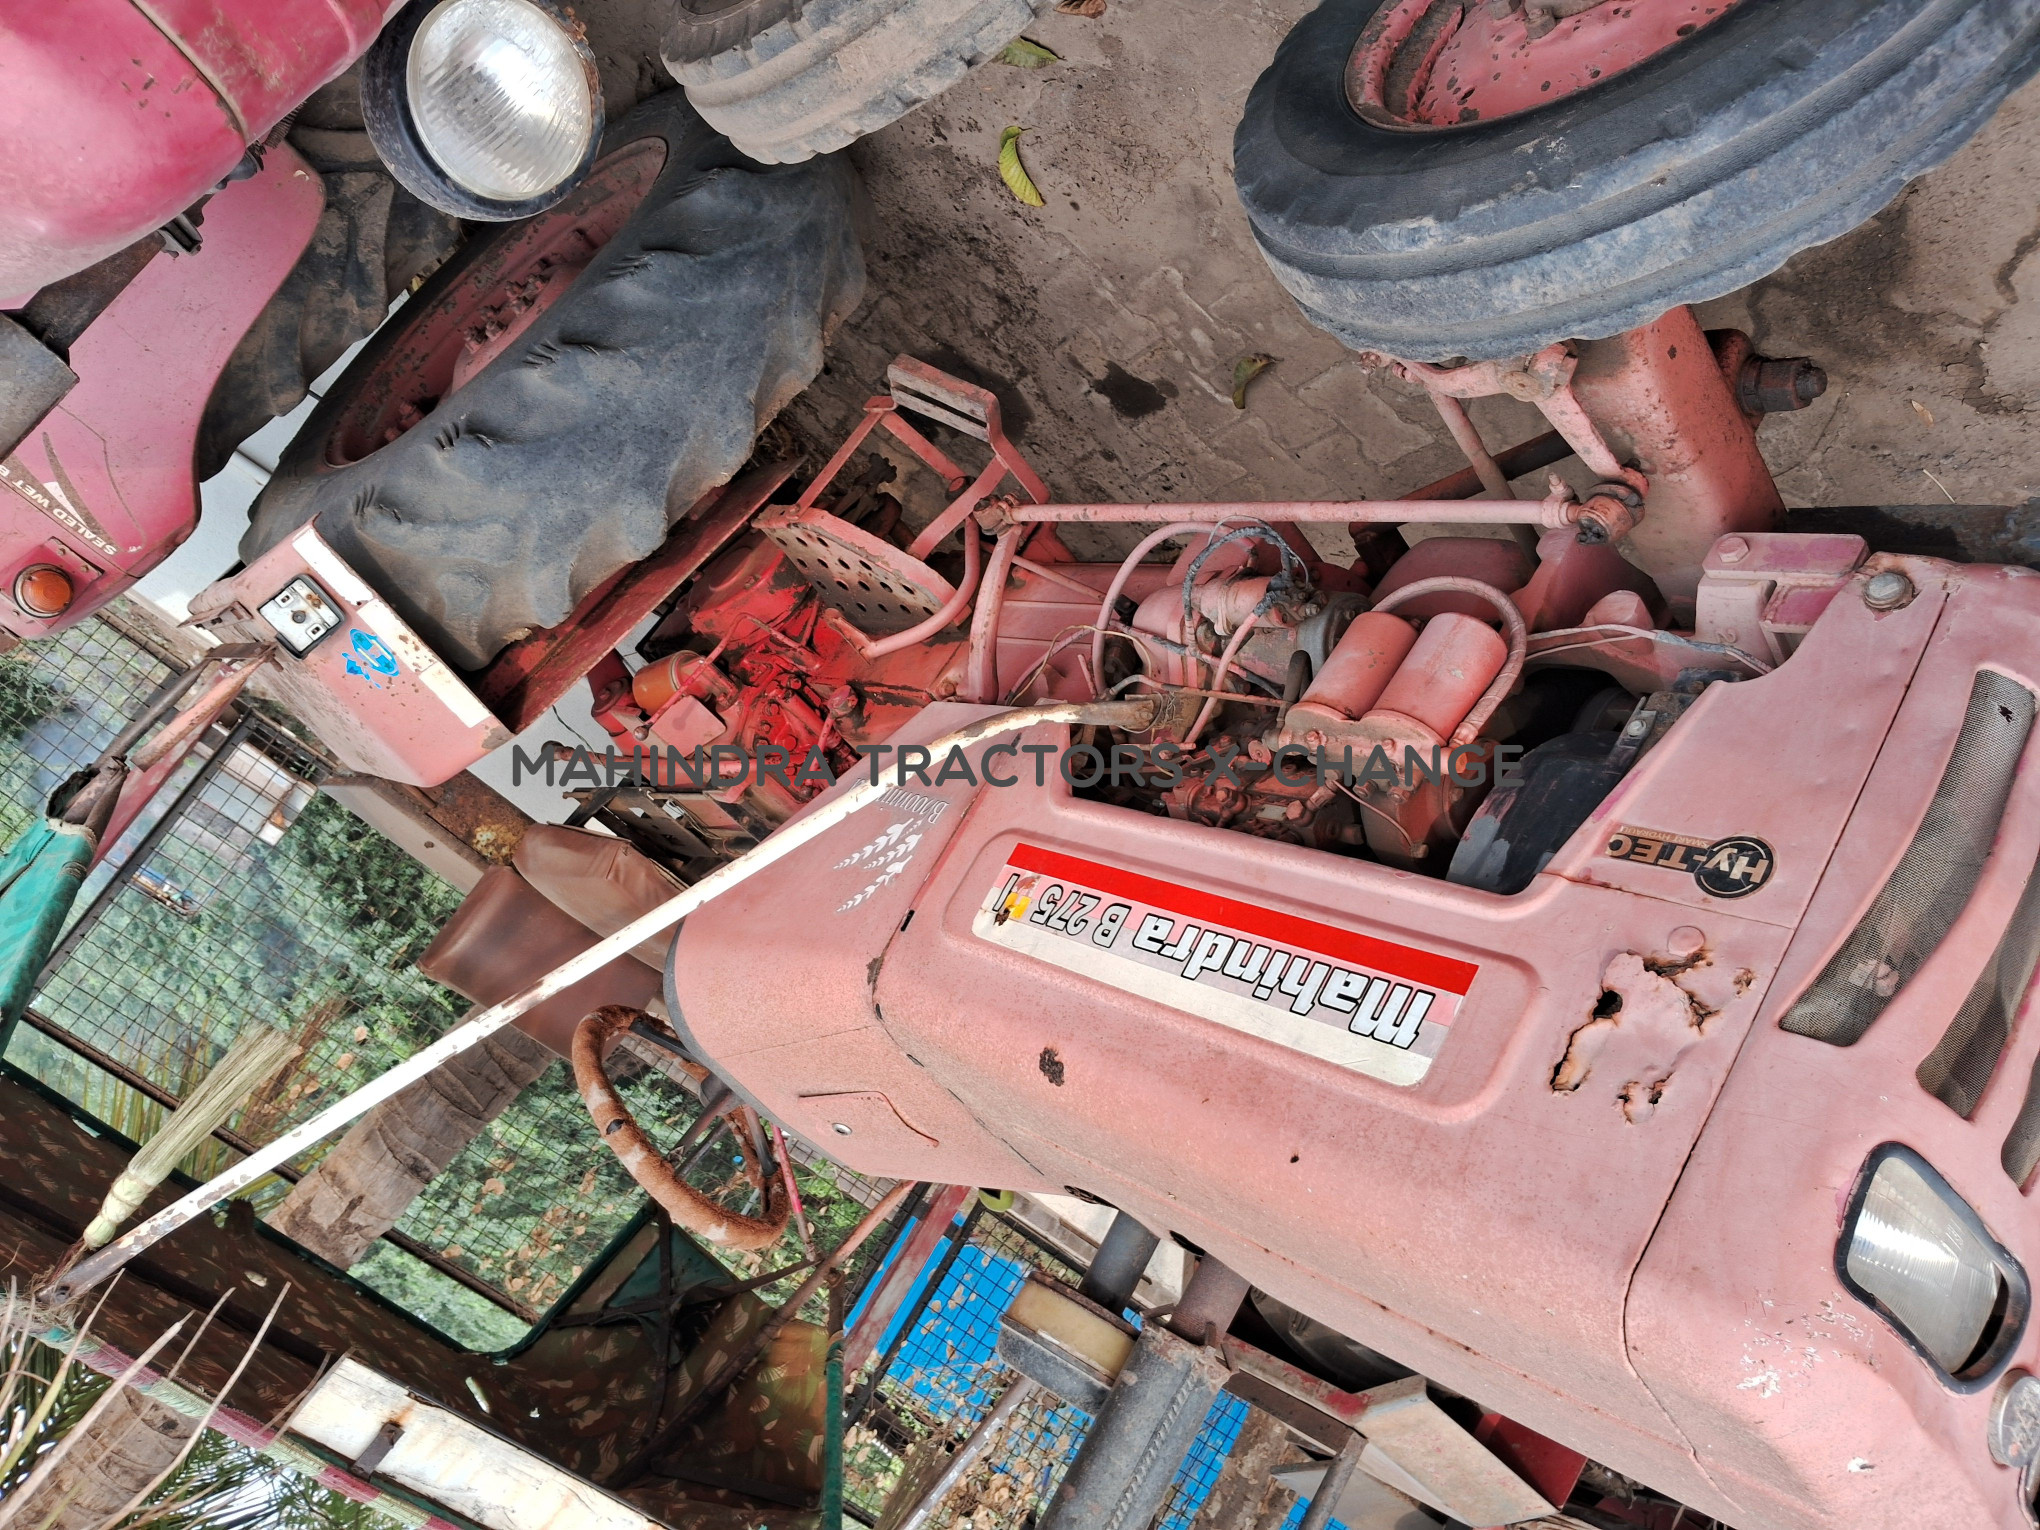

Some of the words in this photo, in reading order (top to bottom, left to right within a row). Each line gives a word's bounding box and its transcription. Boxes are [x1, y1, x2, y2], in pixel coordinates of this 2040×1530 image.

[11, 480, 50, 508] WET
[52, 508, 118, 556] SEALED
[1604, 834, 1769, 884] Hy-TEC
[1673, 835, 1710, 848] SMART
[1029, 883, 1101, 936] 275
[1092, 903, 1132, 948] B
[1132, 913, 1435, 1050] Mahindra
